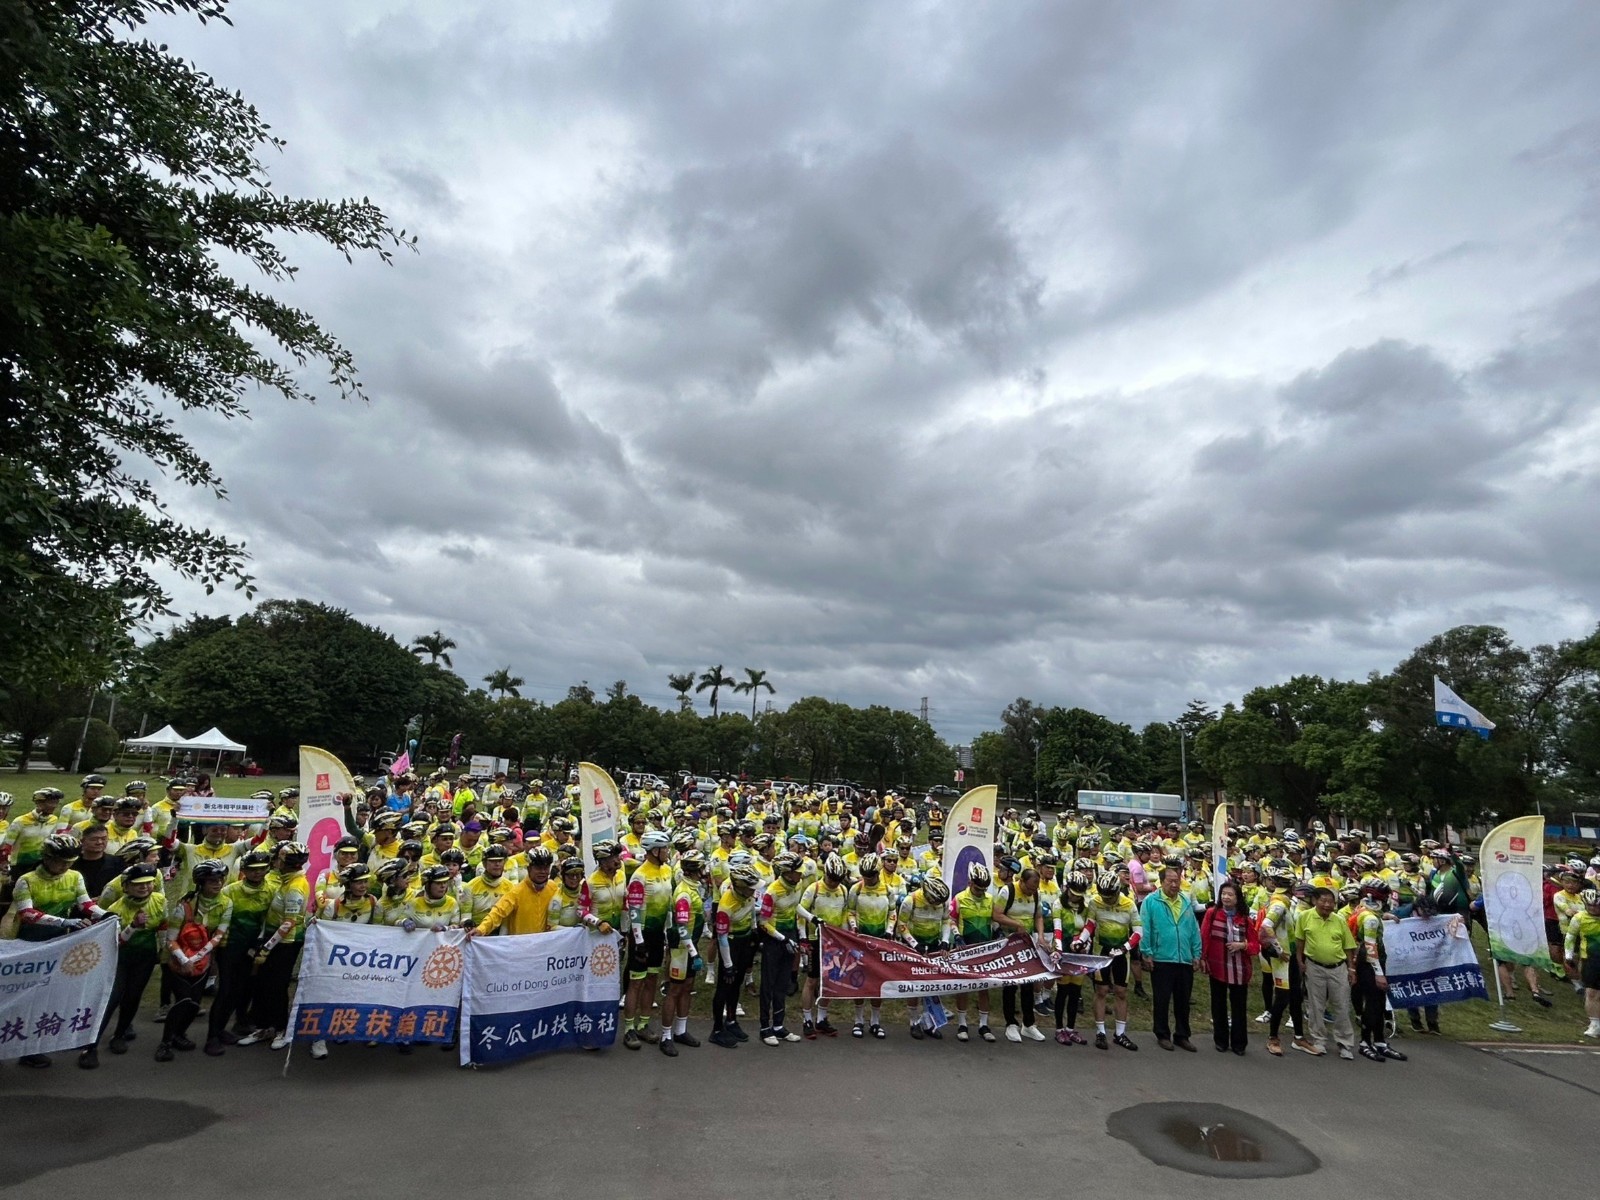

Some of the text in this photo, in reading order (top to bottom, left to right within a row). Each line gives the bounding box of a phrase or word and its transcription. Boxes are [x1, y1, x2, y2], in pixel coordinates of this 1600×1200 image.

[678, 926, 688, 938] 5
[1409, 928, 1446, 942] Rotary
[987, 942, 1002, 951] EPN
[0, 960, 57, 976] otary
[328, 945, 419, 977] Rotary
[547, 956, 588, 971] Rotary
[972, 954, 1015, 972] 3750지구
[361, 973, 371, 981] of
[487, 974, 584, 993] Club of Dong Gua Shan
[920, 982, 989, 992] 2023.10.21~10.28
[478, 1012, 615, 1050] 冬瓜山扶輪社
